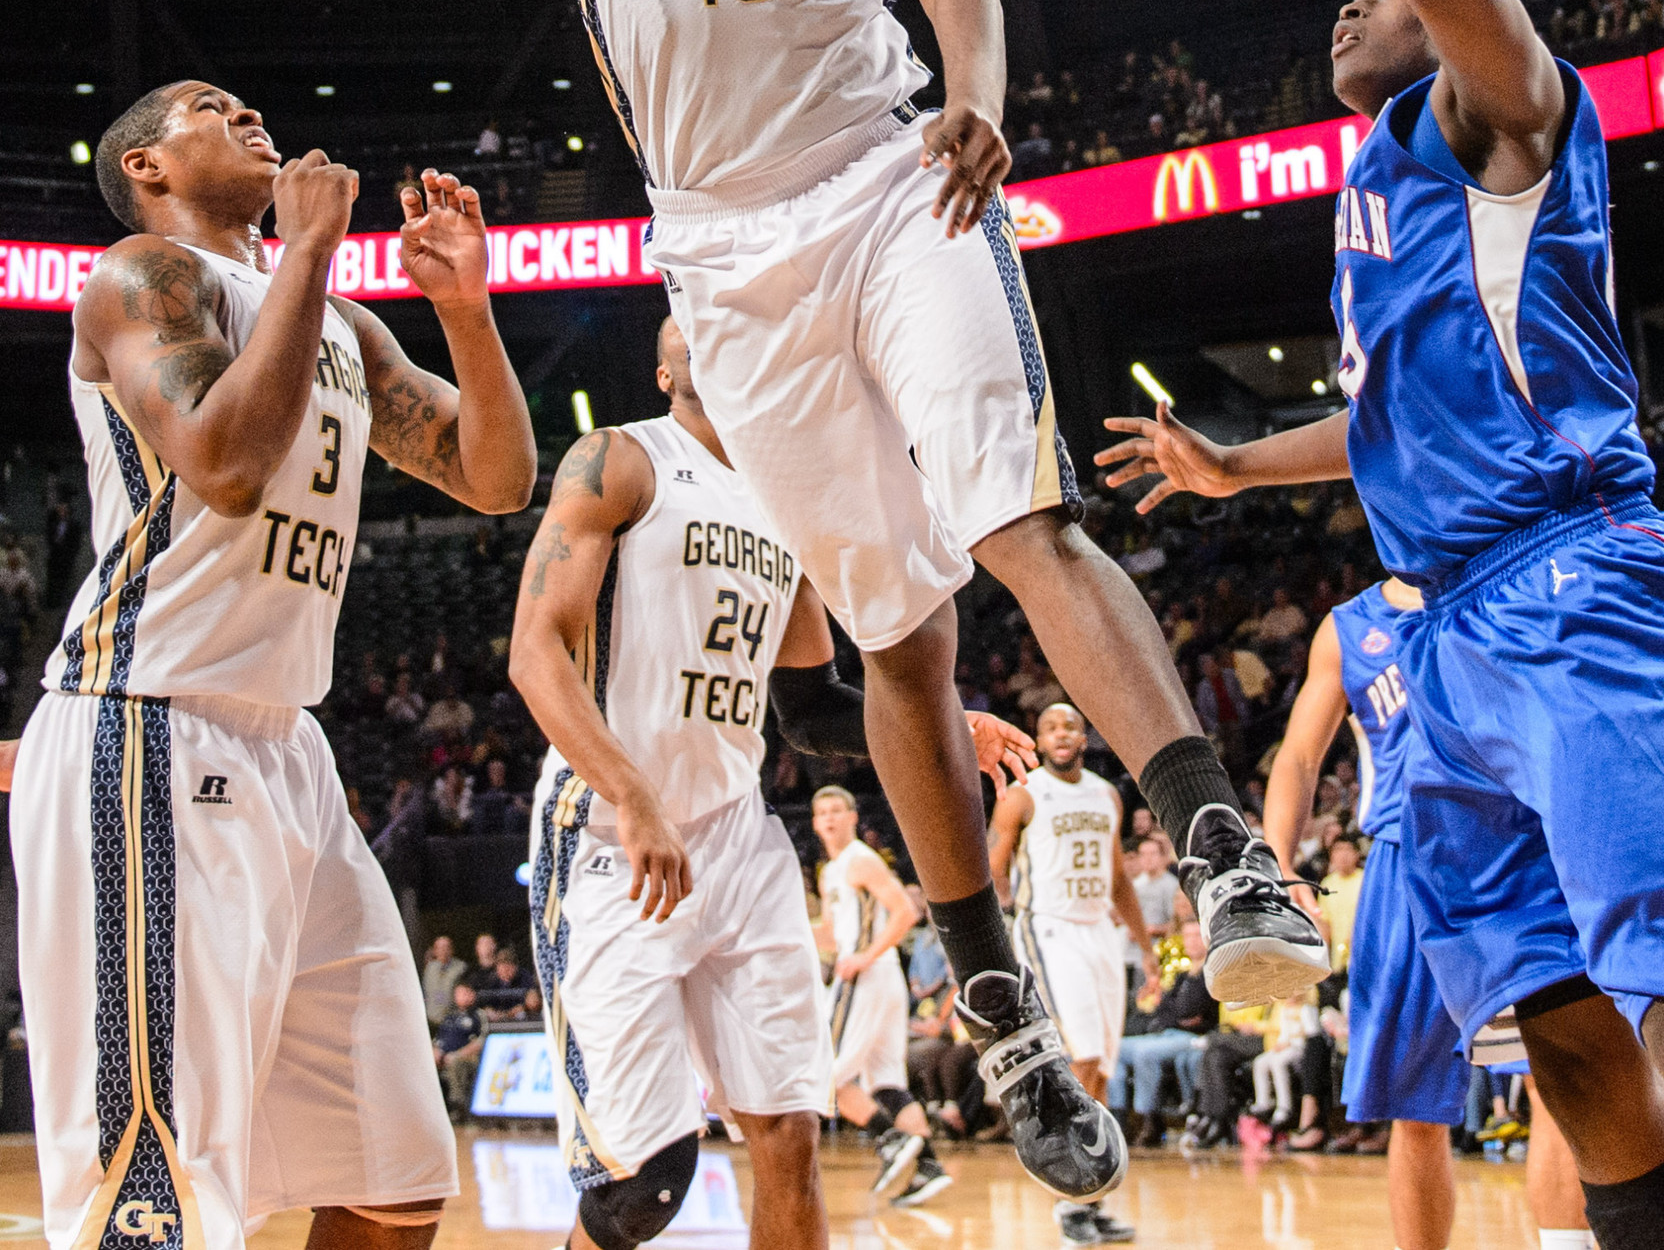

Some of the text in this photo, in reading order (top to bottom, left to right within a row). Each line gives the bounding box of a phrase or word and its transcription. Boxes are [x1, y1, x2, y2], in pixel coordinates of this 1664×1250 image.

[486, 224, 629, 284] ICKEN
[309, 410, 341, 499] 3
[683, 520, 794, 600] GEORGIA
[704, 589, 769, 662] 24
[191, 795, 233, 805] RUSSELL
[1072, 840, 1101, 869] 23
[115, 1199, 177, 1243] GT
